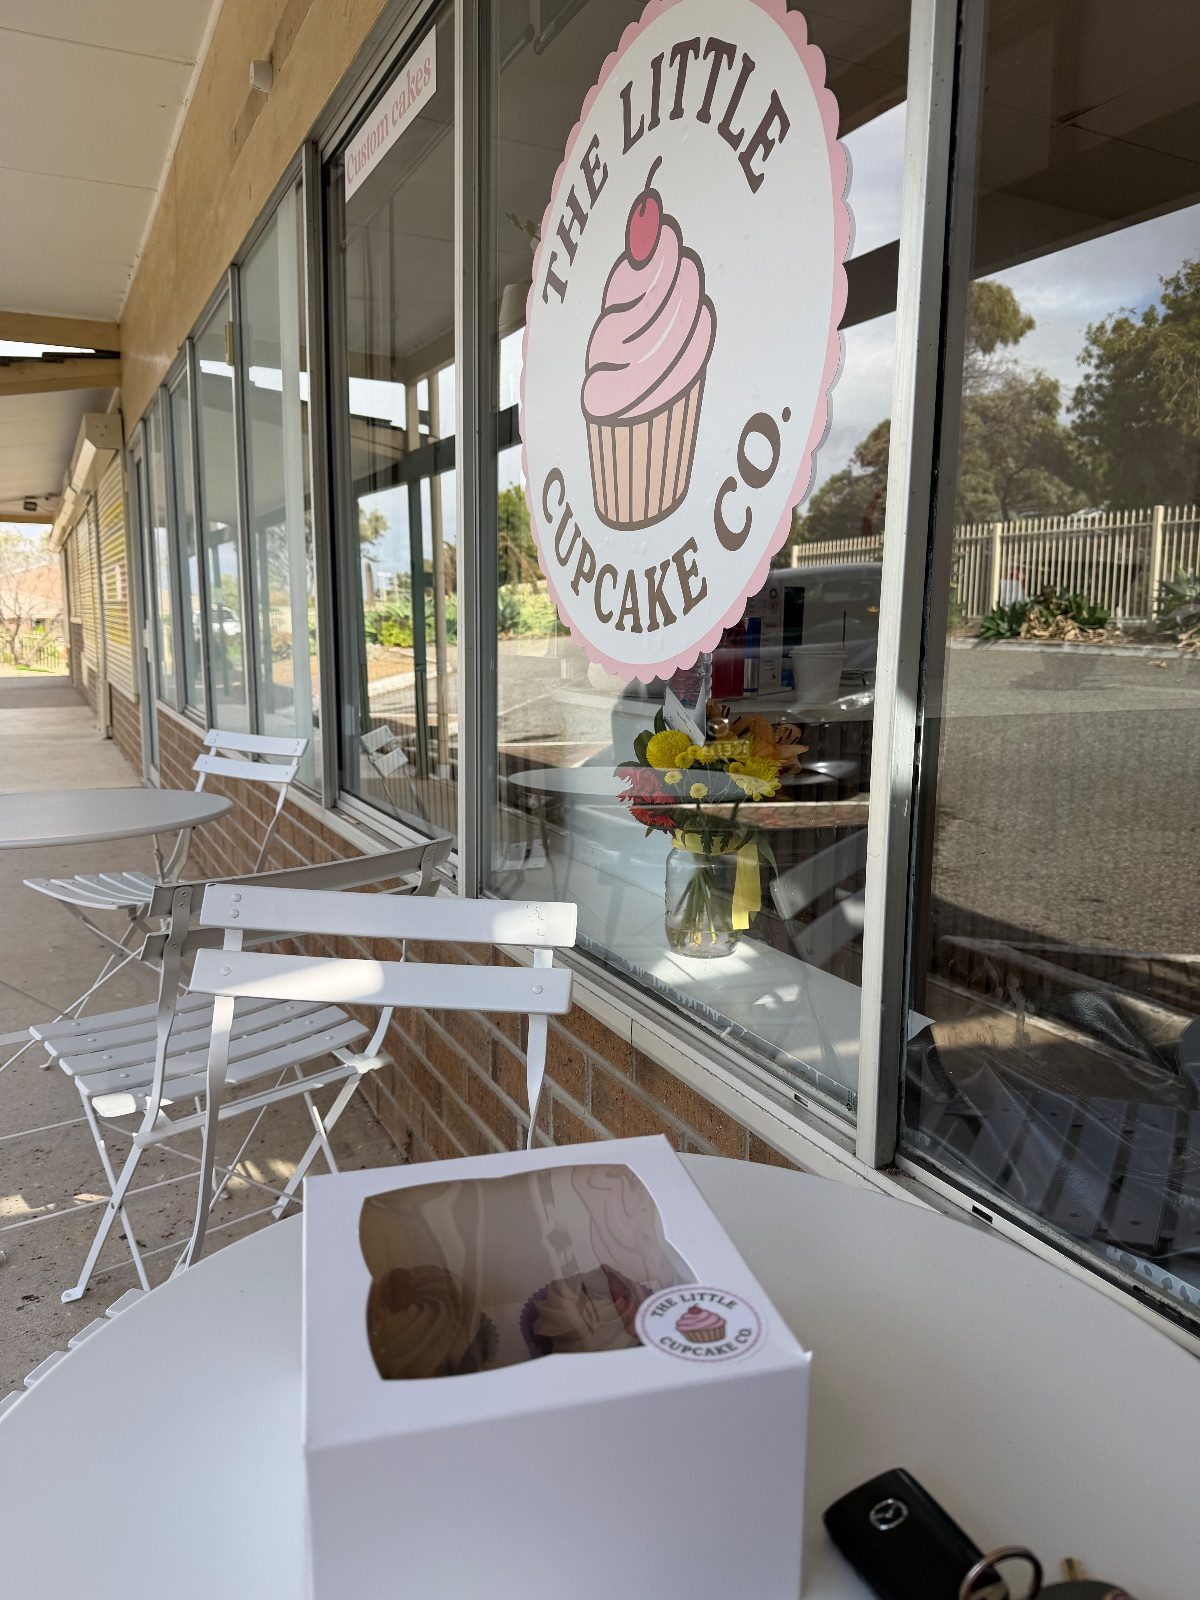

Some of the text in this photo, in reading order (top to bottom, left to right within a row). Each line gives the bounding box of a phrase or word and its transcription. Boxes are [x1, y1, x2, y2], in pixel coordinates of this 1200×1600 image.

[345, 56, 432, 184] Custom cakes
[542, 37, 791, 304] THE LITTLE
[542, 467, 708, 634] CUPCAKE
[650, 1292, 738, 1318] THE LITTLE
[660, 1336, 738, 1357] CUPCAKE
